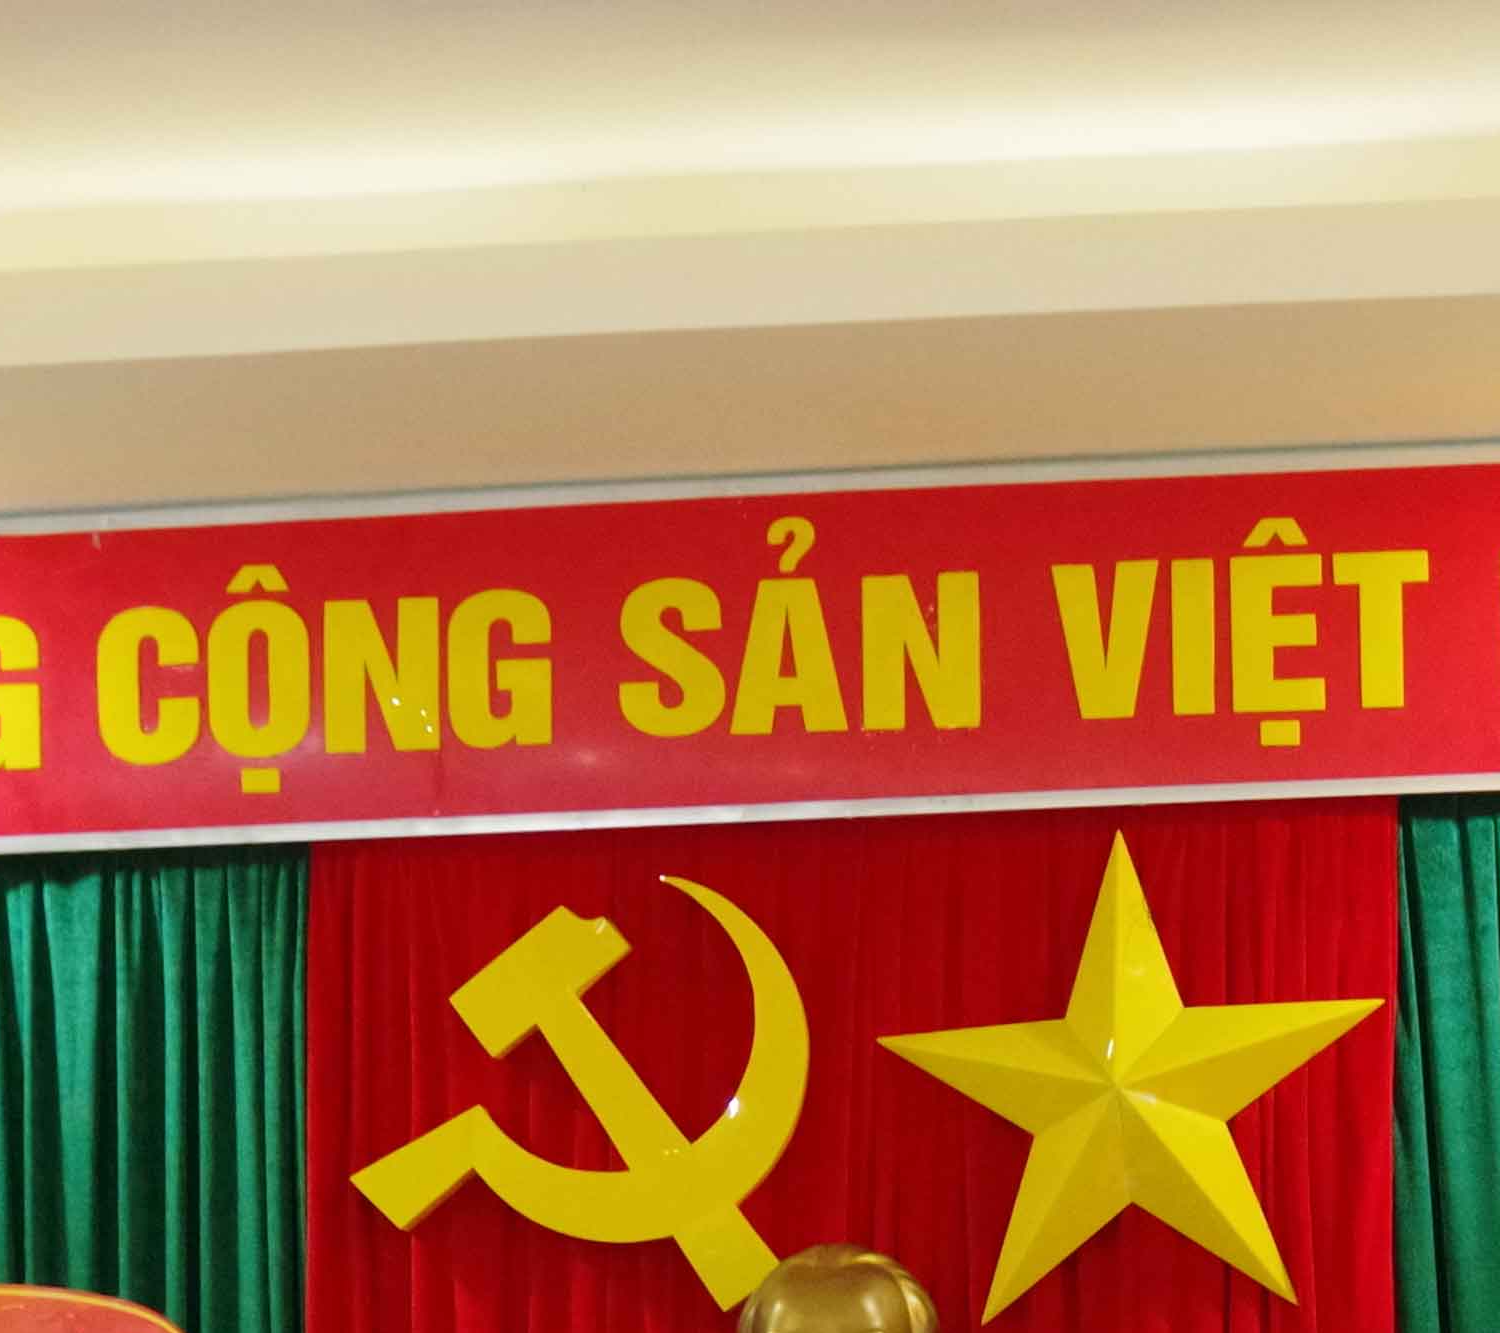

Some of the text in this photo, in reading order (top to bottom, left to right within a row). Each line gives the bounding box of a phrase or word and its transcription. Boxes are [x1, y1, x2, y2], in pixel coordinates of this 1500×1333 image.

[97, 563, 553, 794] CỘNG
[618, 516, 981, 736] SẢN
[1052, 516, 1429, 747] VIỆT
